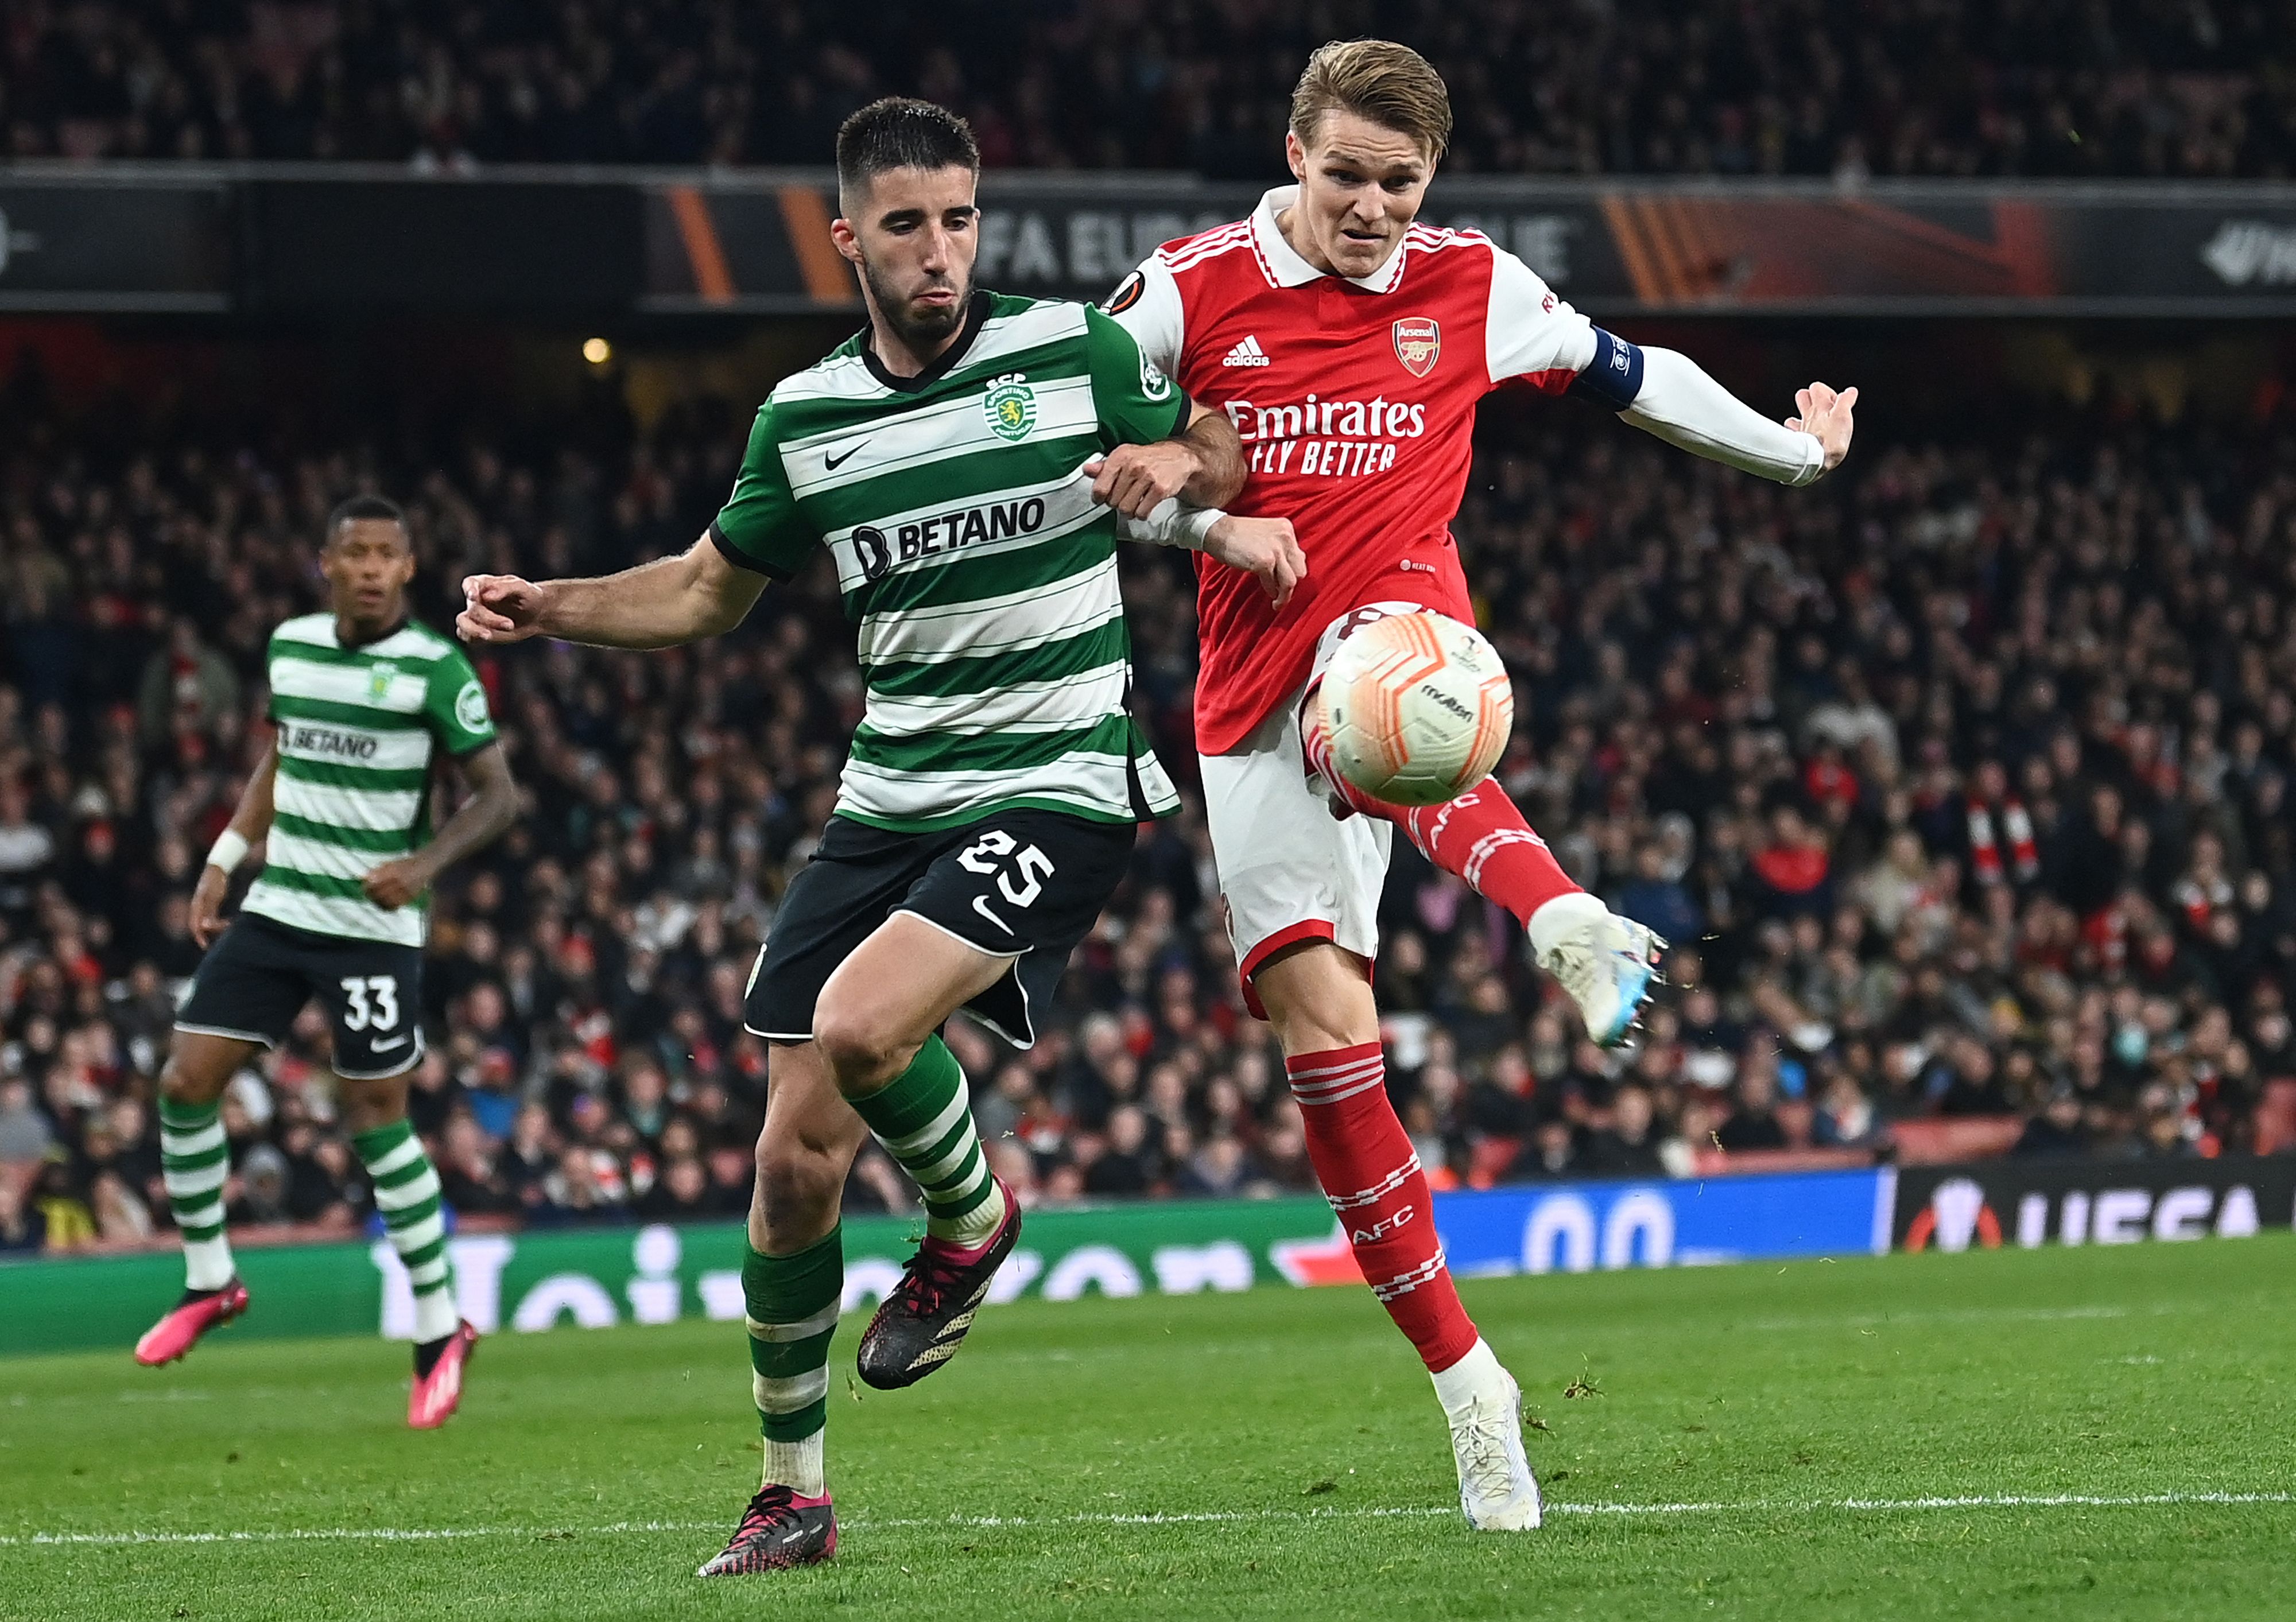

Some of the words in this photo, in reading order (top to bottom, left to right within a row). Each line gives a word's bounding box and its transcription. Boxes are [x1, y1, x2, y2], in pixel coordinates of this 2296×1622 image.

[1399, 327, 1433, 337] Arsenal
[1223, 354, 1270, 367] adidas
[986, 372, 1026, 391] SCP
[1224, 394, 1425, 440] Emirates
[1251, 440, 1297, 474] FLY
[1300, 440, 1397, 477] BETTER
[897, 498, 1045, 561] BETANO
[1421, 684, 1474, 723] molten
[293, 727, 377, 759] BETANO
[956, 829, 1055, 908] 25
[340, 976, 400, 1031] 33
[1353, 1205, 1414, 1245] AFC
